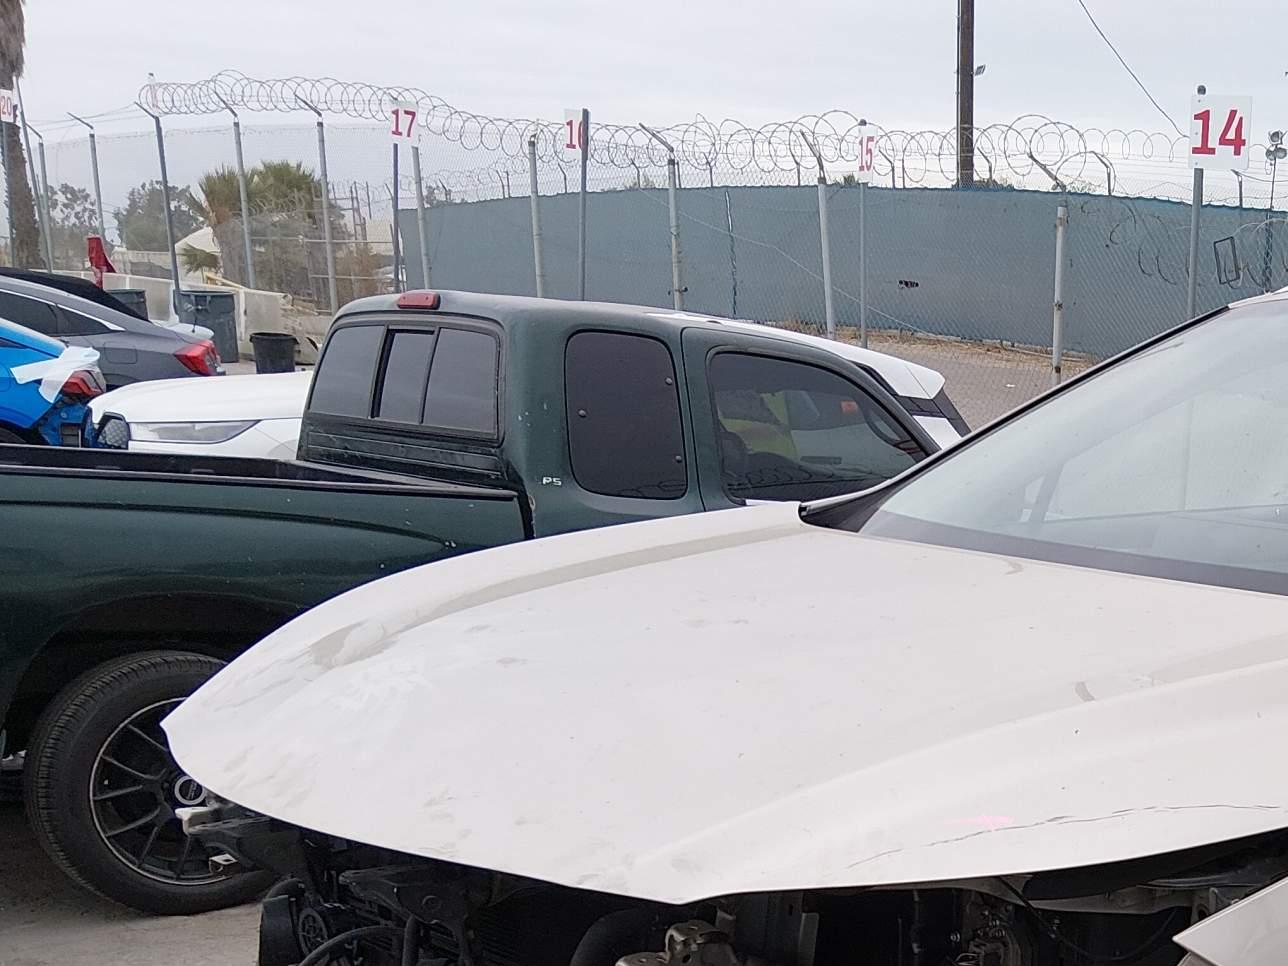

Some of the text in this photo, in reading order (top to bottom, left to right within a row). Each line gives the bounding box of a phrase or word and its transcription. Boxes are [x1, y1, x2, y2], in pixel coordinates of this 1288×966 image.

[391, 109, 416, 137] 17
[1192, 109, 1246, 156] 14
[859, 135, 875, 171] 15
